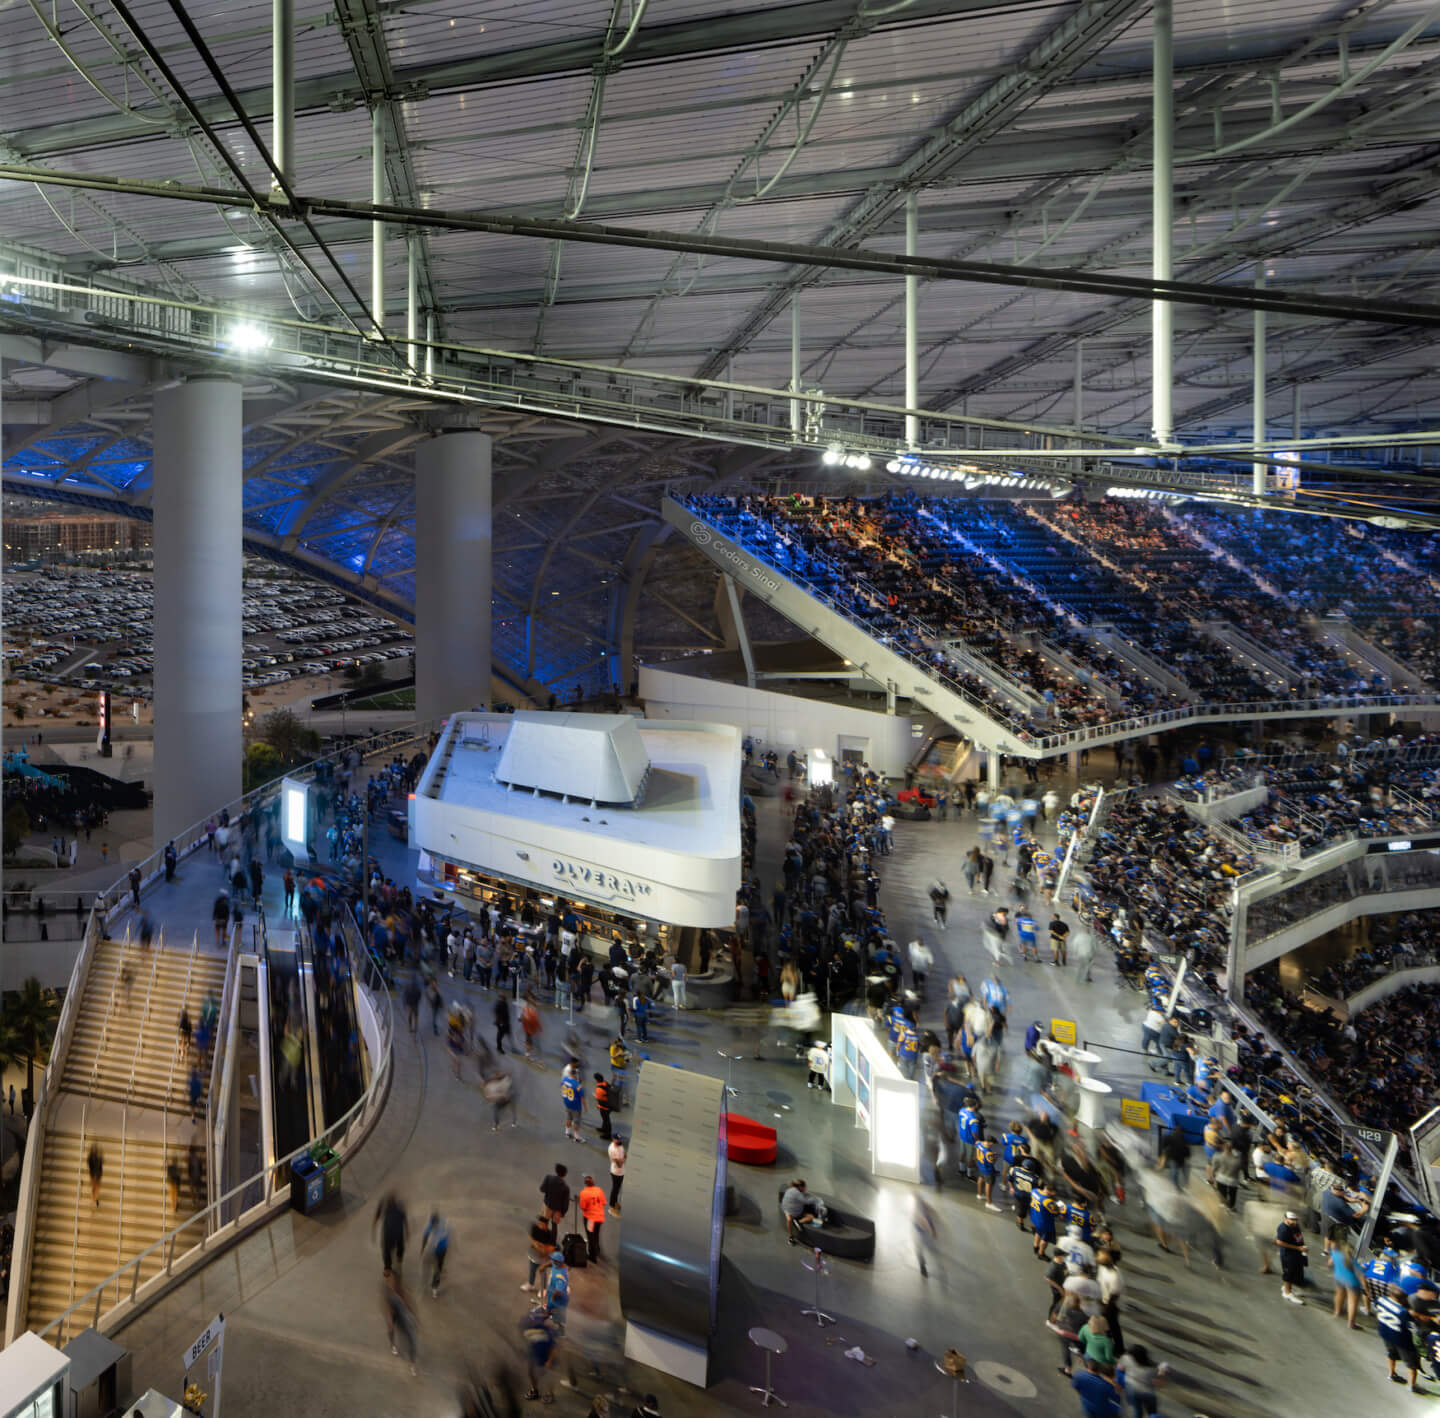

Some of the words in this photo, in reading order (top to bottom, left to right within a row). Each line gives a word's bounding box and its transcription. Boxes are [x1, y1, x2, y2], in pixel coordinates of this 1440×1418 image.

[713, 540, 750, 570] Cedars
[751, 566, 782, 592] Sinai
[553, 858, 636, 898] OLVERA
[1358, 1129, 1382, 1142] 429
[192, 1328, 211, 1360] BEER
